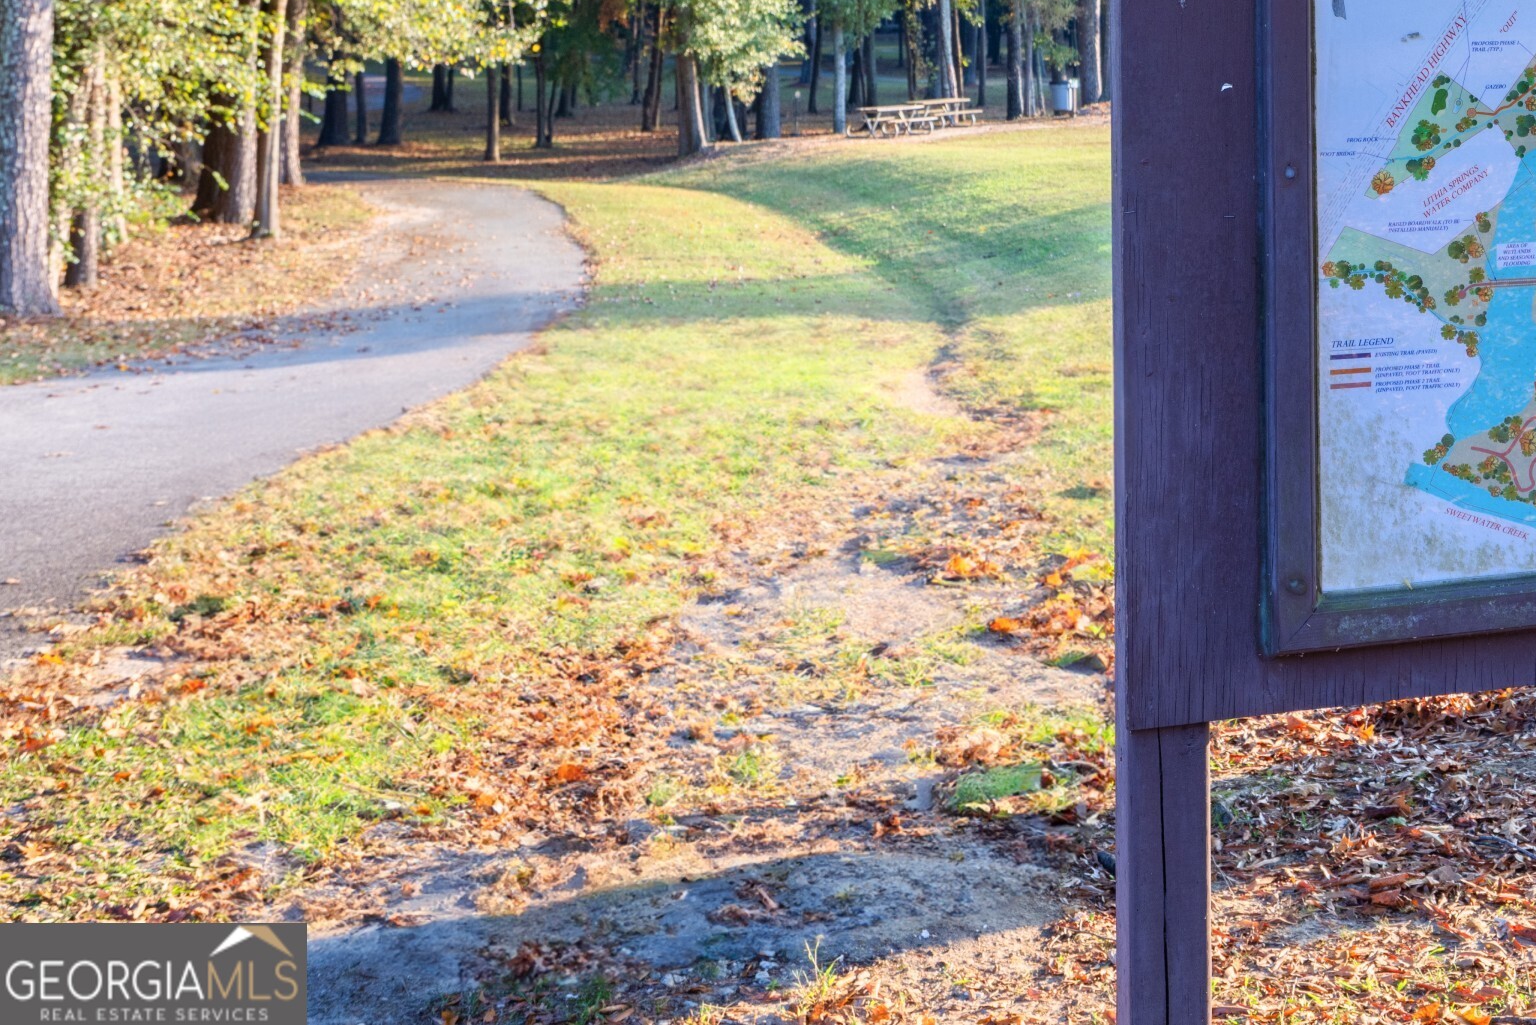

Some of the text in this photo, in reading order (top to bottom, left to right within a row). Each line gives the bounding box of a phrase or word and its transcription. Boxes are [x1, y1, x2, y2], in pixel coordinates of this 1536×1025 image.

[1386, 13, 1467, 128] BANKHEAD HIGHWAY
[1422, 168, 1490, 219] WATER COMPANY
[1423, 164, 1480, 208] LITHIA SPRINGS
[1331, 337, 1394, 348] TRAIL LEGEND
[1375, 371, 1405, 379] (UNPAVED,
[1375, 385, 1405, 394] (UNPAVED,
[1445, 507, 1530, 541] SWEETWATER CREEK
